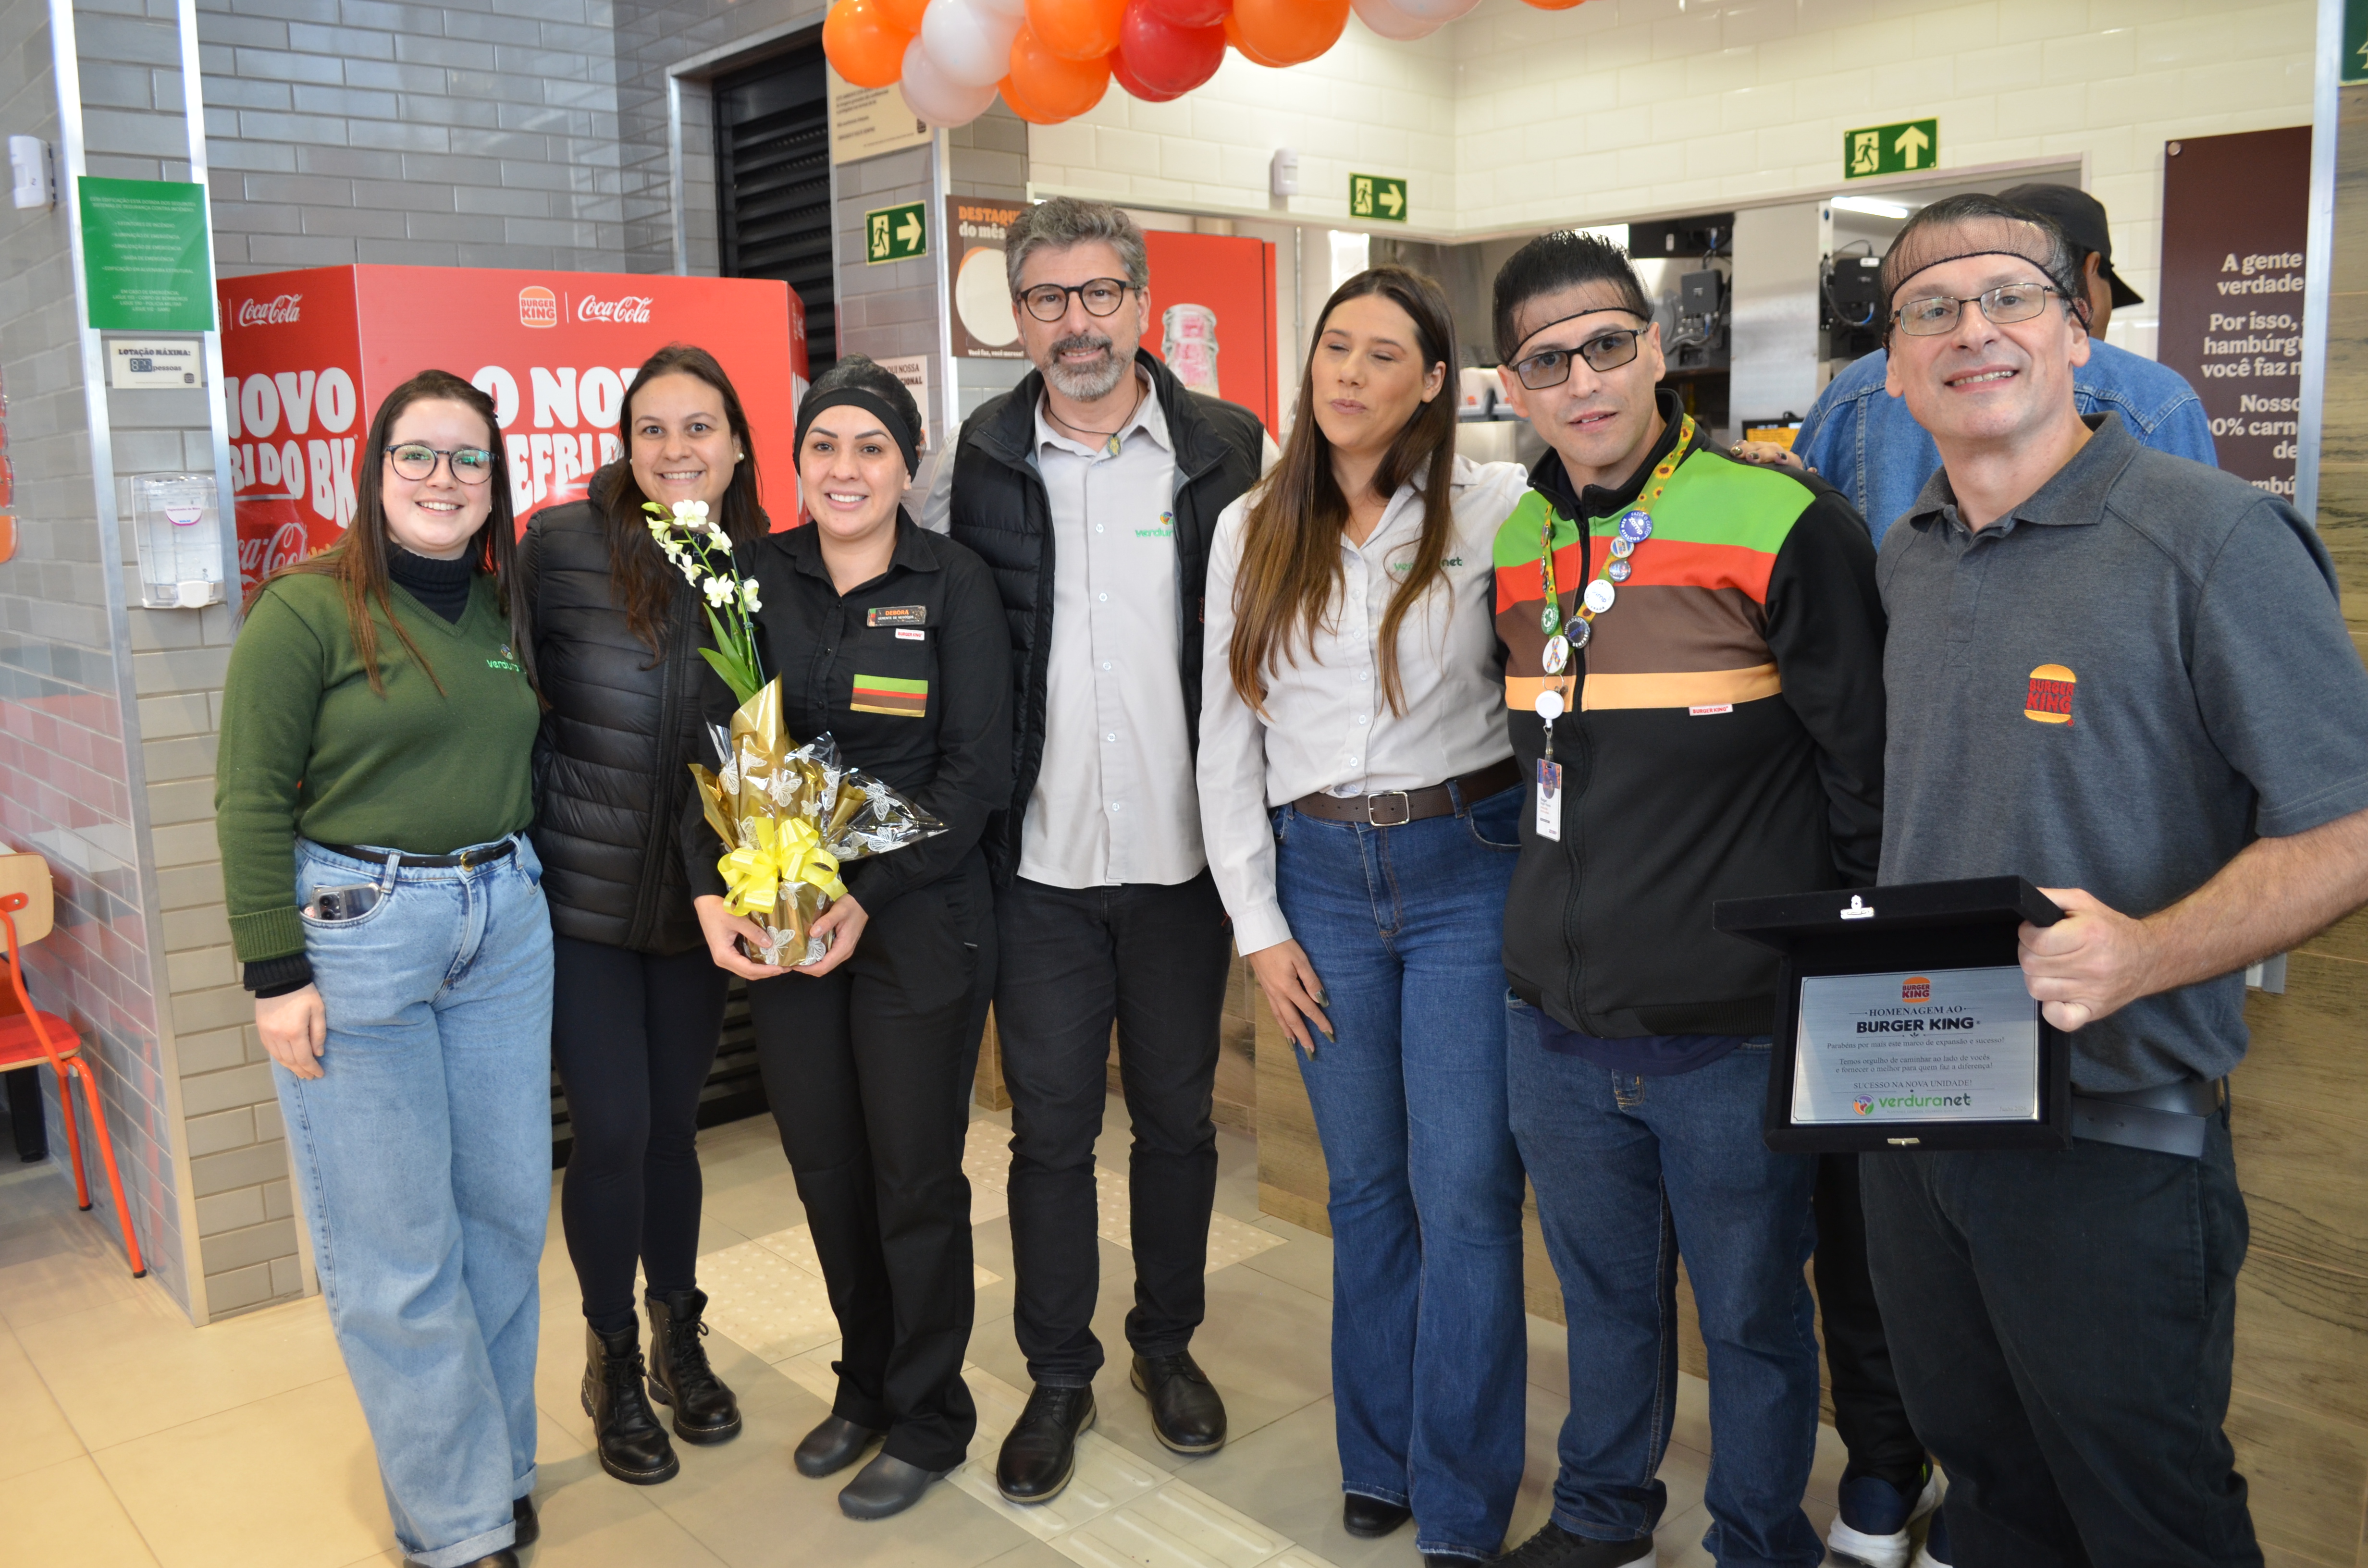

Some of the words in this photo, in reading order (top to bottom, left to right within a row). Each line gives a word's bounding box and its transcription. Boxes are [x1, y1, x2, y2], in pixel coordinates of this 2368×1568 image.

[959, 220, 977, 238] do
[978, 222, 1006, 240] mês
[2221, 253, 2239, 272] A
[2242, 252, 2304, 275] gente
[521, 299, 555, 307] BURGER
[578, 294, 653, 323] Coca-Cola
[522, 308, 555, 318] KING
[2209, 313, 2246, 331] Por
[2249, 310, 2298, 331] isso,
[118, 347, 154, 356] LOTAÇÃO
[899, 363, 920, 373] NOSSA
[2201, 357, 2251, 378] você
[2254, 356, 2287, 377] faz
[259, 439, 305, 500] DO
[2029, 678, 2074, 696] BURGER
[2026, 691, 2072, 714] KING
[1902, 990, 1930, 998] KING
[1869, 1006, 1944, 1017] HOMENAGEM
[1946, 1005, 1962, 1013] AO
[1856, 1019, 1924, 1033] BURGER
[1929, 1017, 1974, 1030] KING
[1936, 1038, 1967, 1046] expansão
[1862, 1057, 1888, 1066] orgulho
[1878, 1092, 1971, 1107] verduranet
